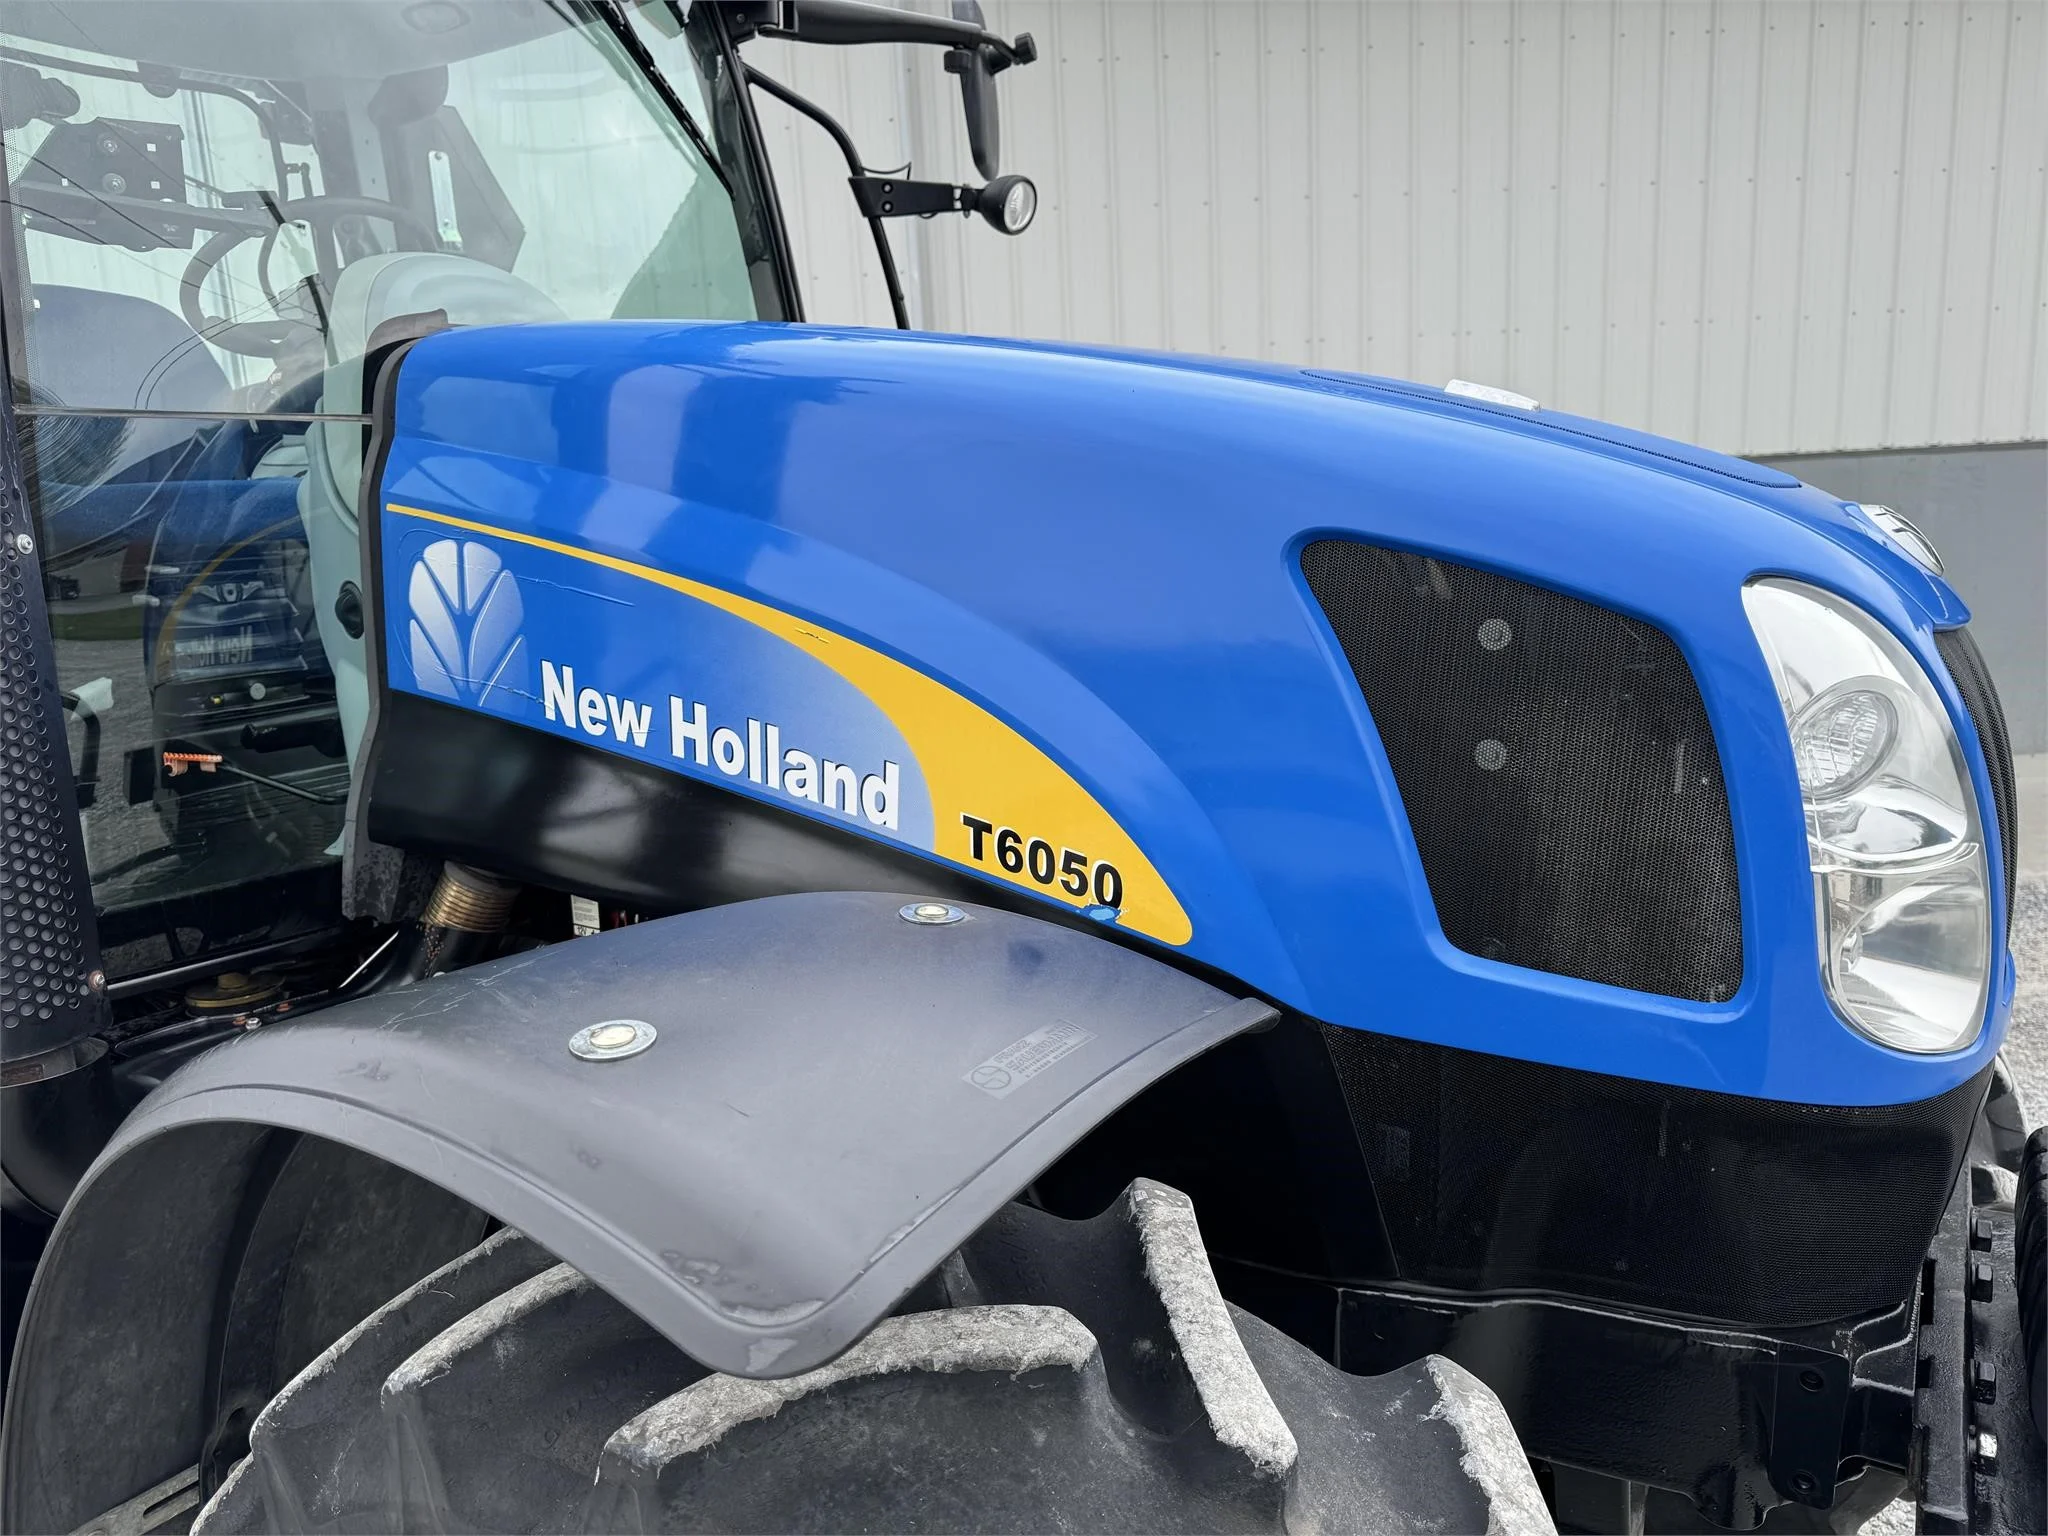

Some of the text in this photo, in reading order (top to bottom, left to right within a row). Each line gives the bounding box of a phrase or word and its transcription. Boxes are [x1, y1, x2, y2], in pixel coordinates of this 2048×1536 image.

[541, 659, 899, 831] New Holland
[960, 812, 1123, 910] T6050
